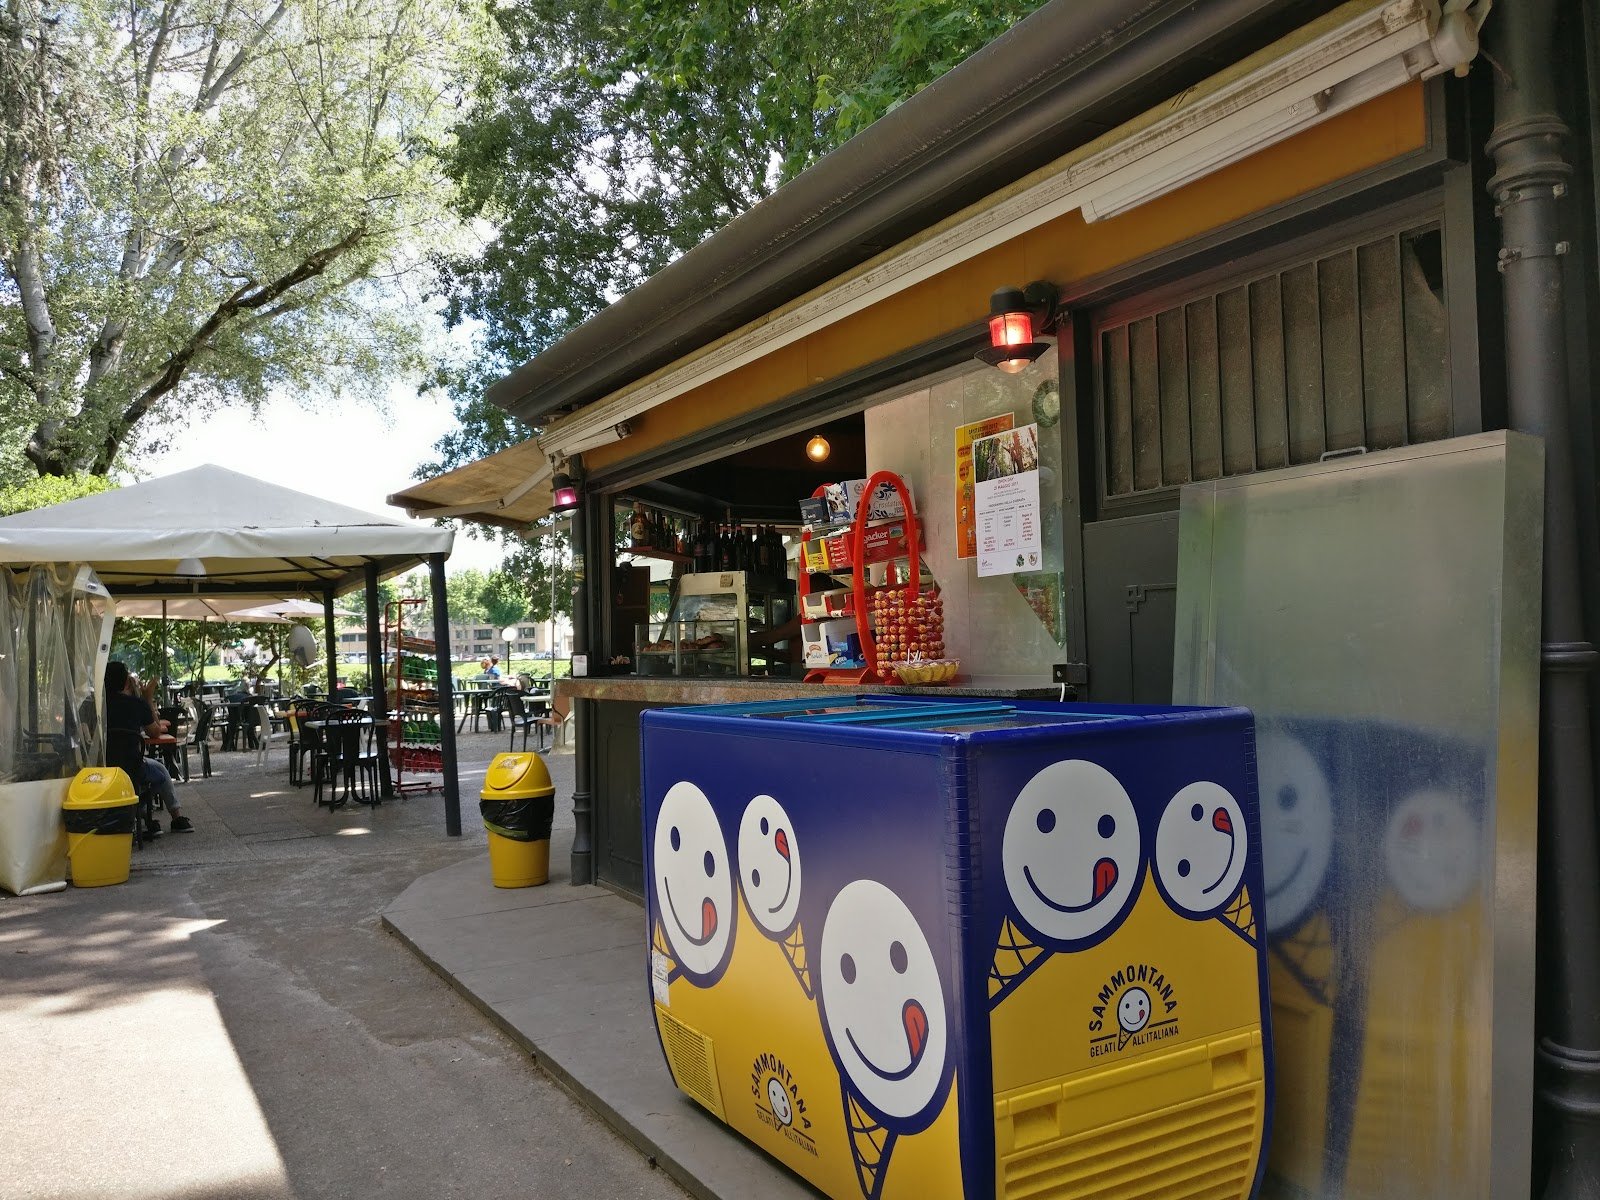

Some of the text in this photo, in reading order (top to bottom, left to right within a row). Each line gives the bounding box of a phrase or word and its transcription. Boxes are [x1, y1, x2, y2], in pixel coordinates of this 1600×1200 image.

[1089, 964, 1178, 1032] SAMMONTANA
[1090, 1025, 1179, 1058] GELATI ALL'ITALIANA
[751, 1052, 812, 1129] SAMMONTANA
